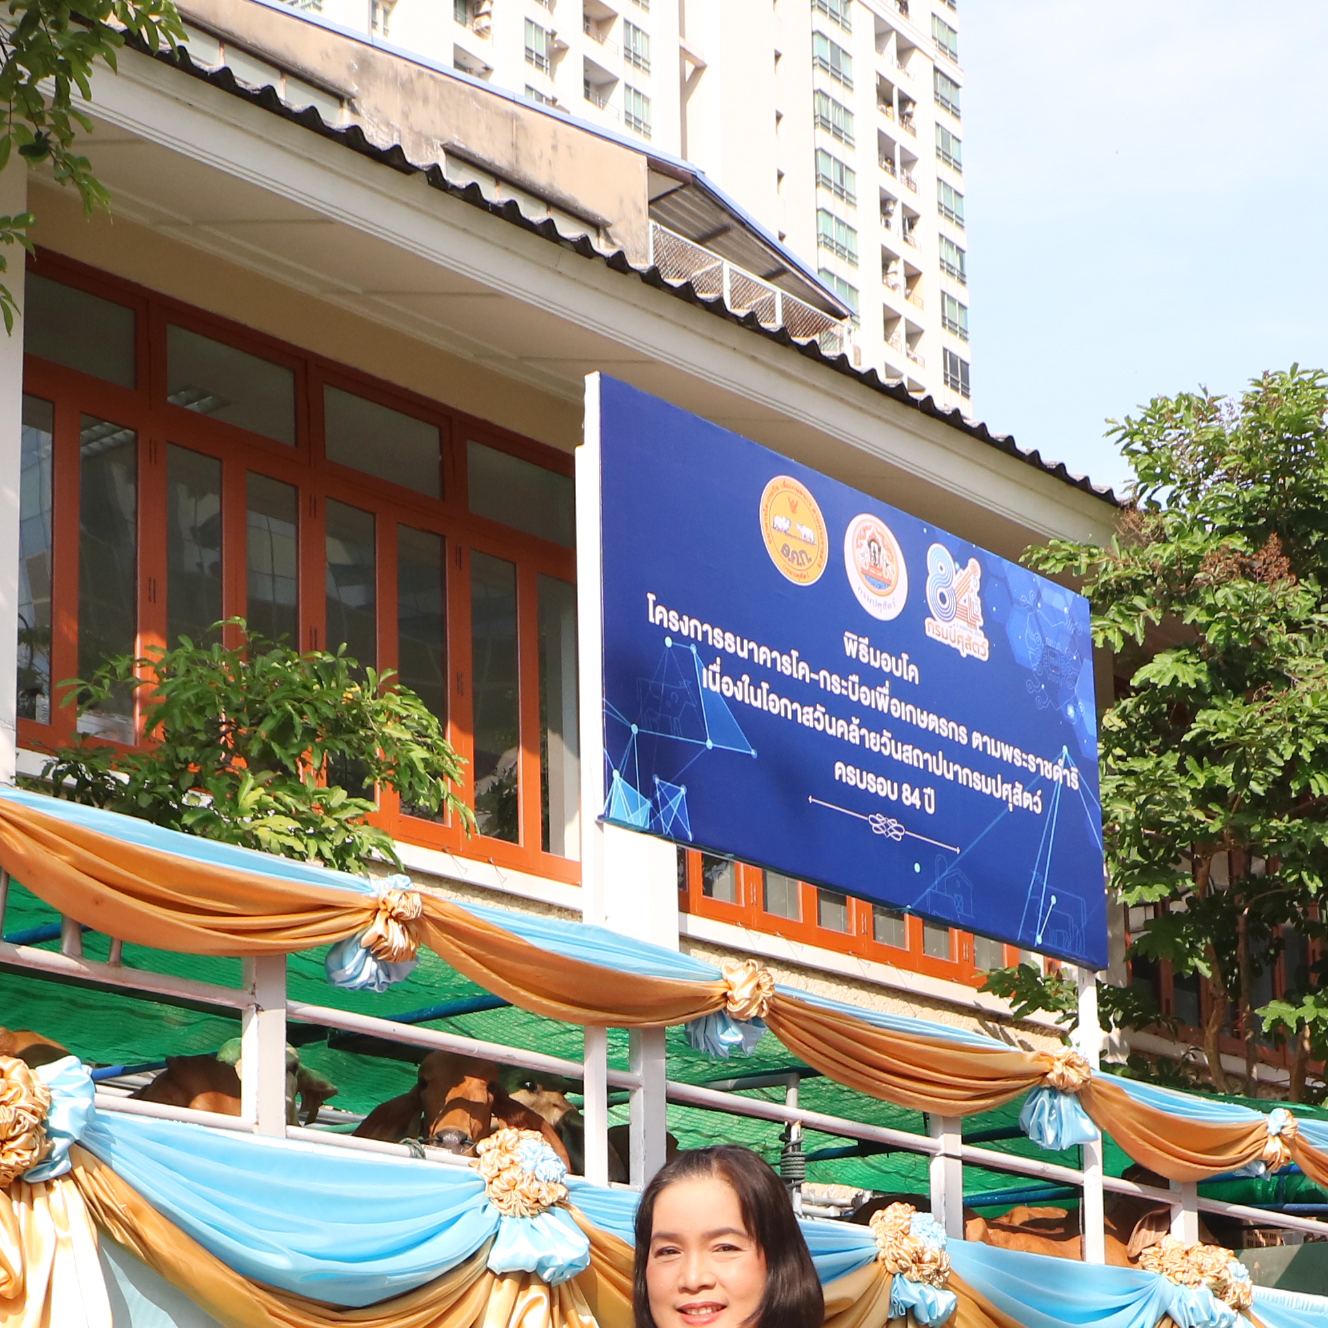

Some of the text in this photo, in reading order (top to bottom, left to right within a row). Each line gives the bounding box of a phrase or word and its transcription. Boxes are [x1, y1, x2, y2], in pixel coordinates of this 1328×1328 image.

[843, 631, 920, 684] พิธีมอบโค
[927, 620, 987, 657] กรมปศุสัตว์
[646, 592, 1080, 791] โครงการธนาคารโค-กระบือเพื่อเกษตรกร ตามพระราชดำริ
[702, 657, 1043, 815] เนื่องในโอกาสวันคล้ายวันสถาปนากรมปศุสัตว์
[834, 761, 935, 815] ครบรอบ 84 ปี
